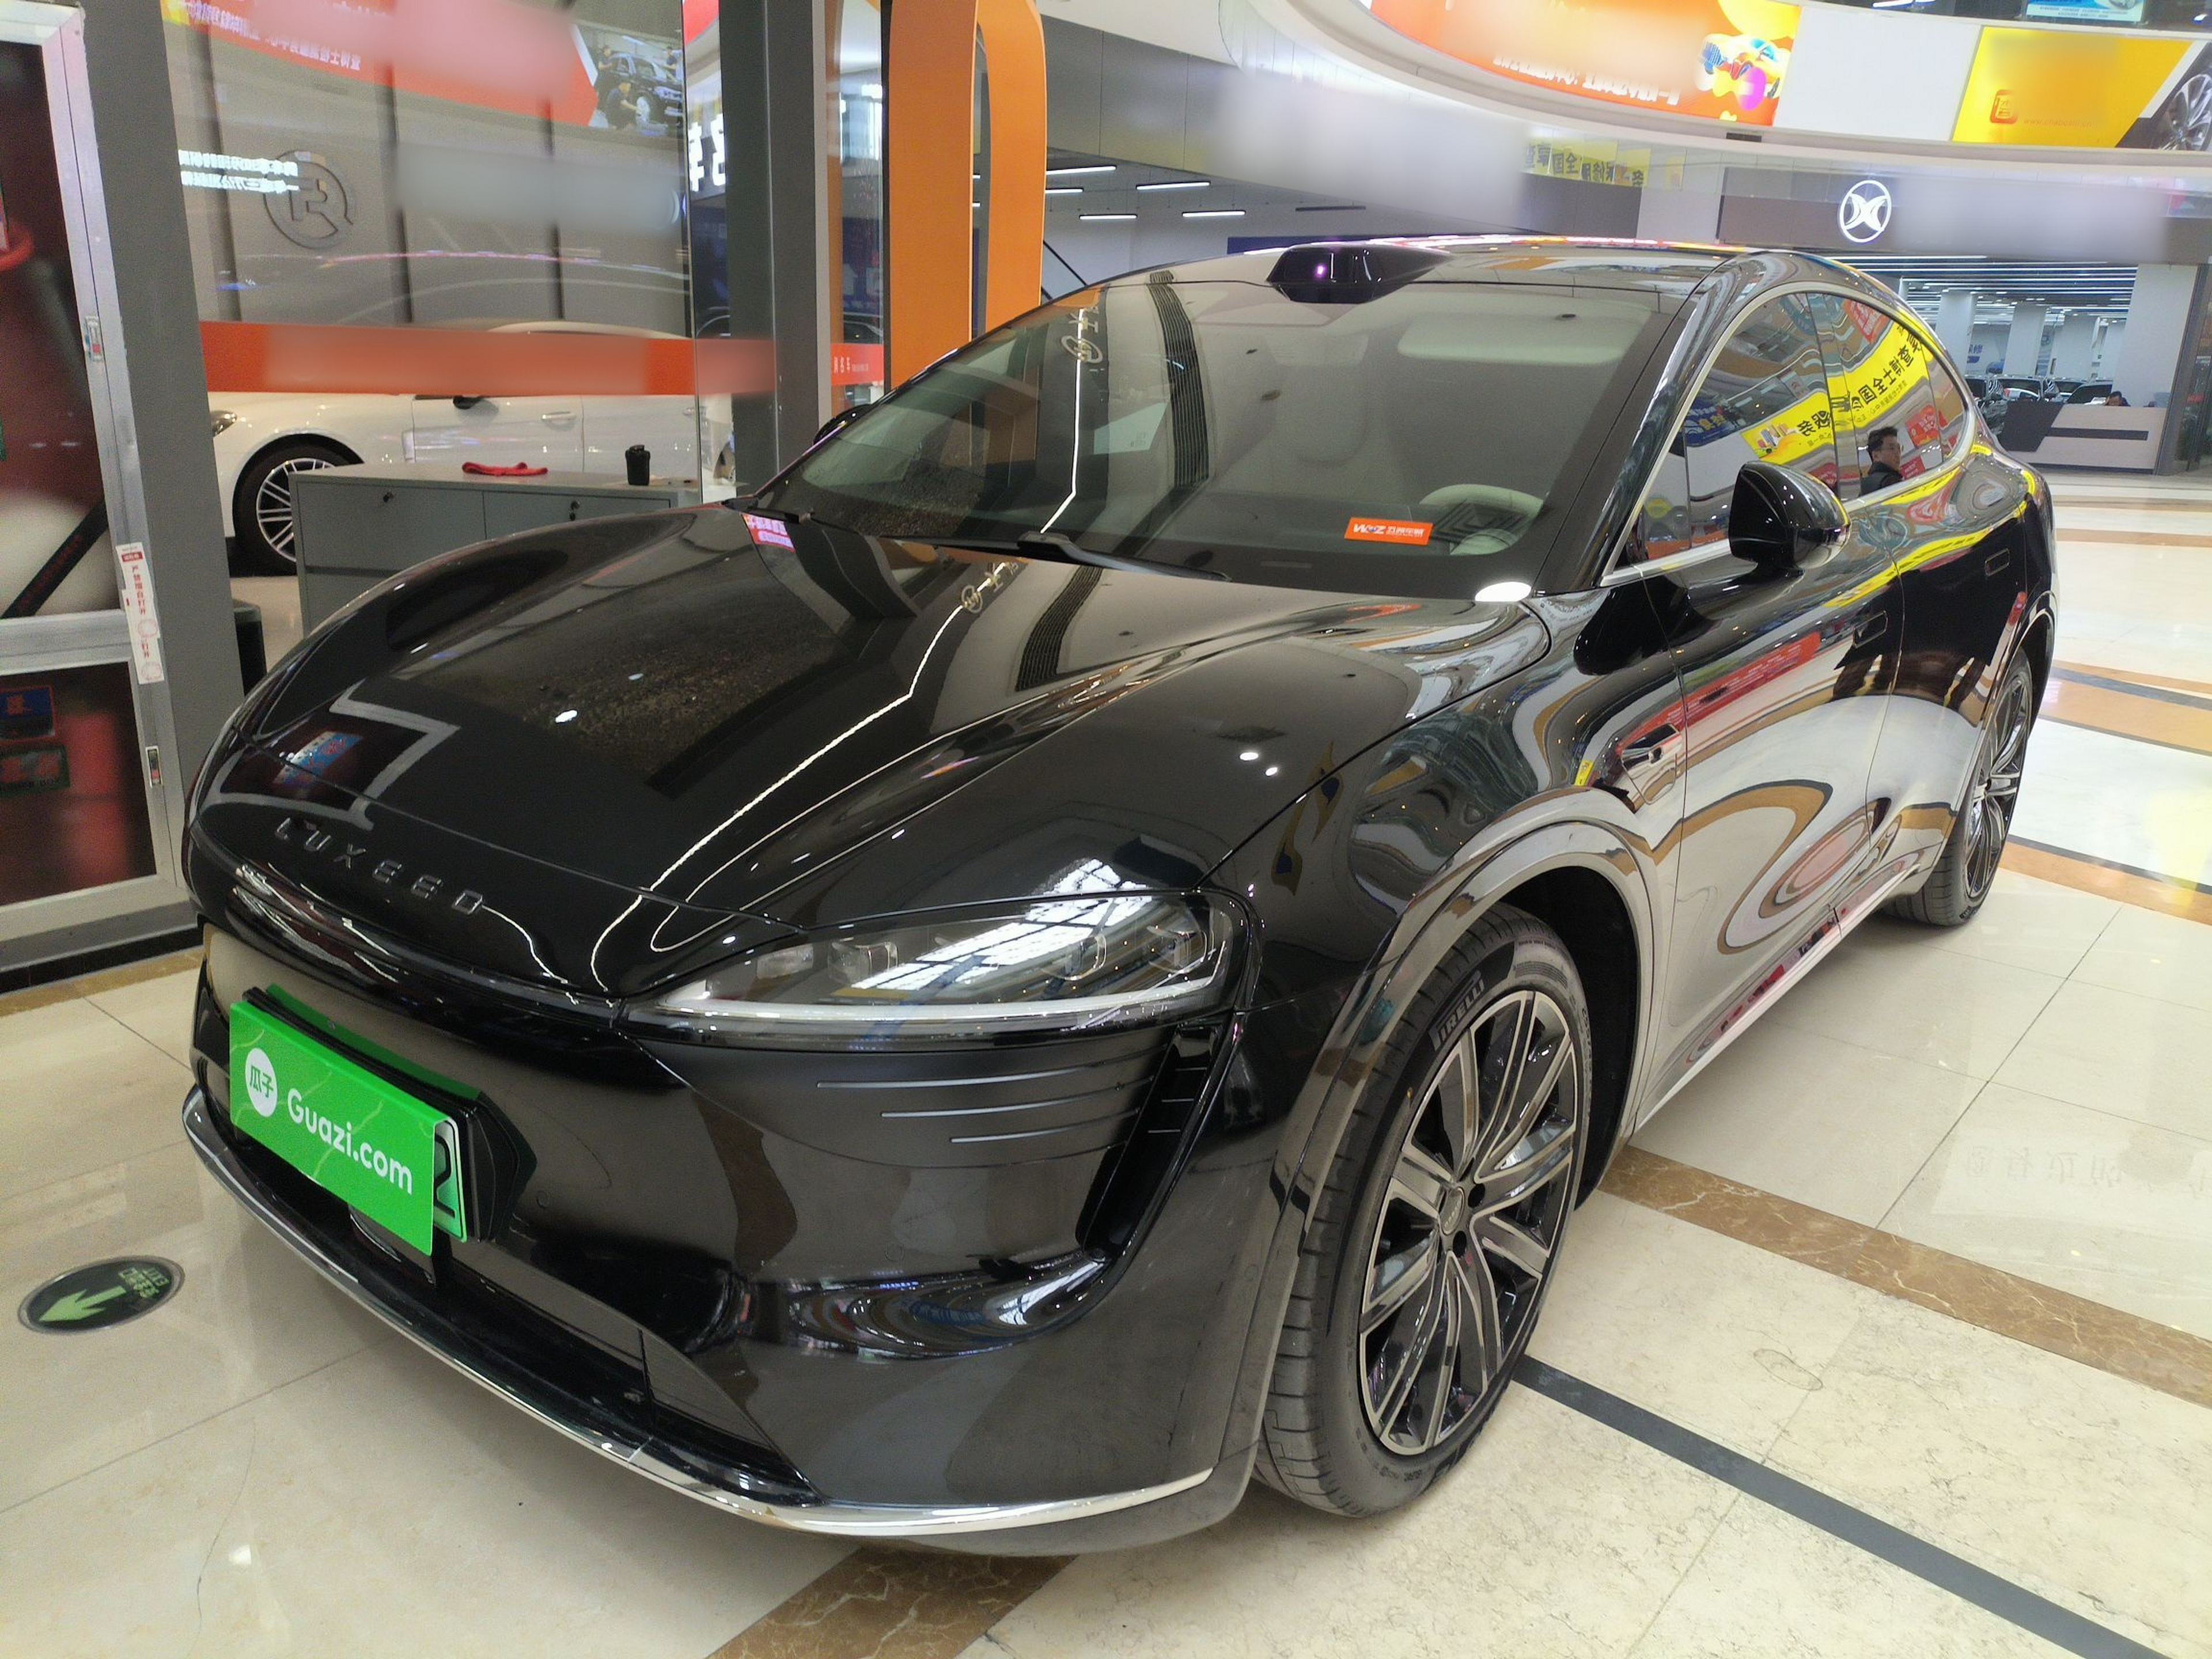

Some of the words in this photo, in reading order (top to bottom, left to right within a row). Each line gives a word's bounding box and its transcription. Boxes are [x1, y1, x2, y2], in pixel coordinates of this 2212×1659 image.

[276, 817, 483, 915] LUXEED
[1428, 969, 1485, 1052] PIRELLI
[249, 1064, 274, 1099] 瓜子
[287, 1088, 413, 1196] Guazi.com
